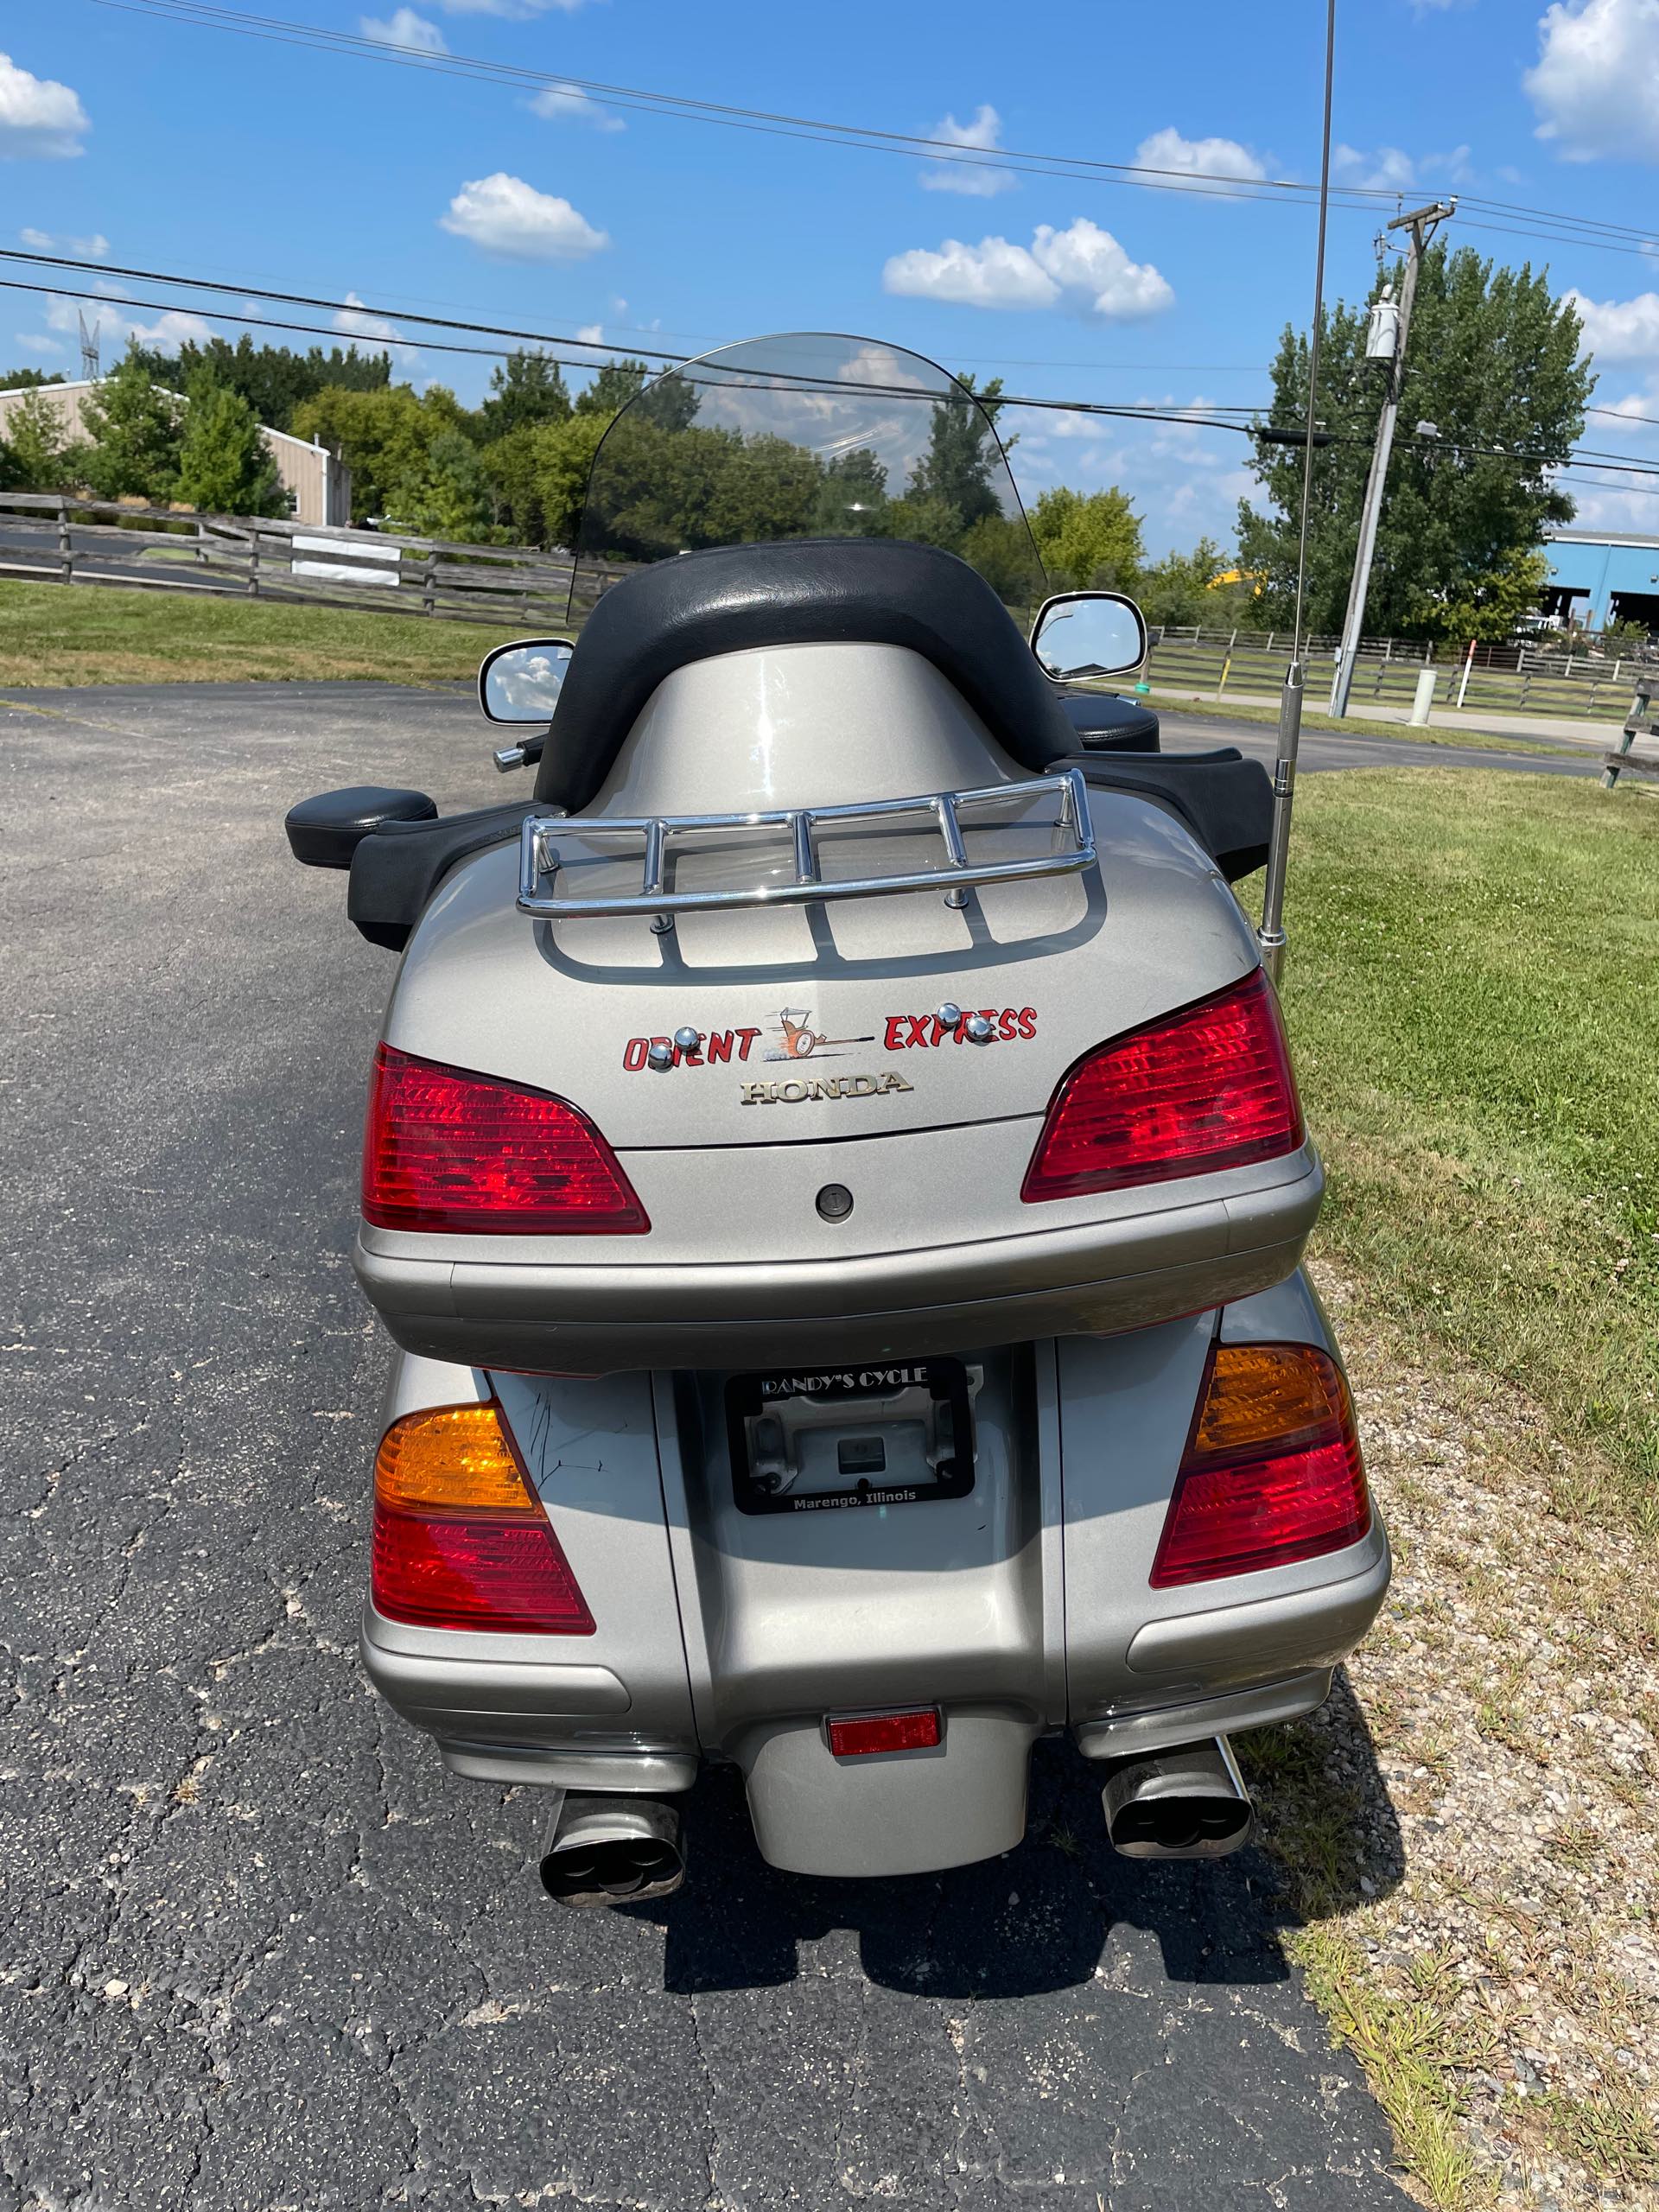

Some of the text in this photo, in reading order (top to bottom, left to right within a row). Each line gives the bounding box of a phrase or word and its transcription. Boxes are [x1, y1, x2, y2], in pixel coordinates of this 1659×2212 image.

[741, 1071, 914, 1106] HONDA
[761, 1367, 928, 1395] RANDY'S CYCLE
[794, 1490, 916, 1510] Marengo, Illinois
